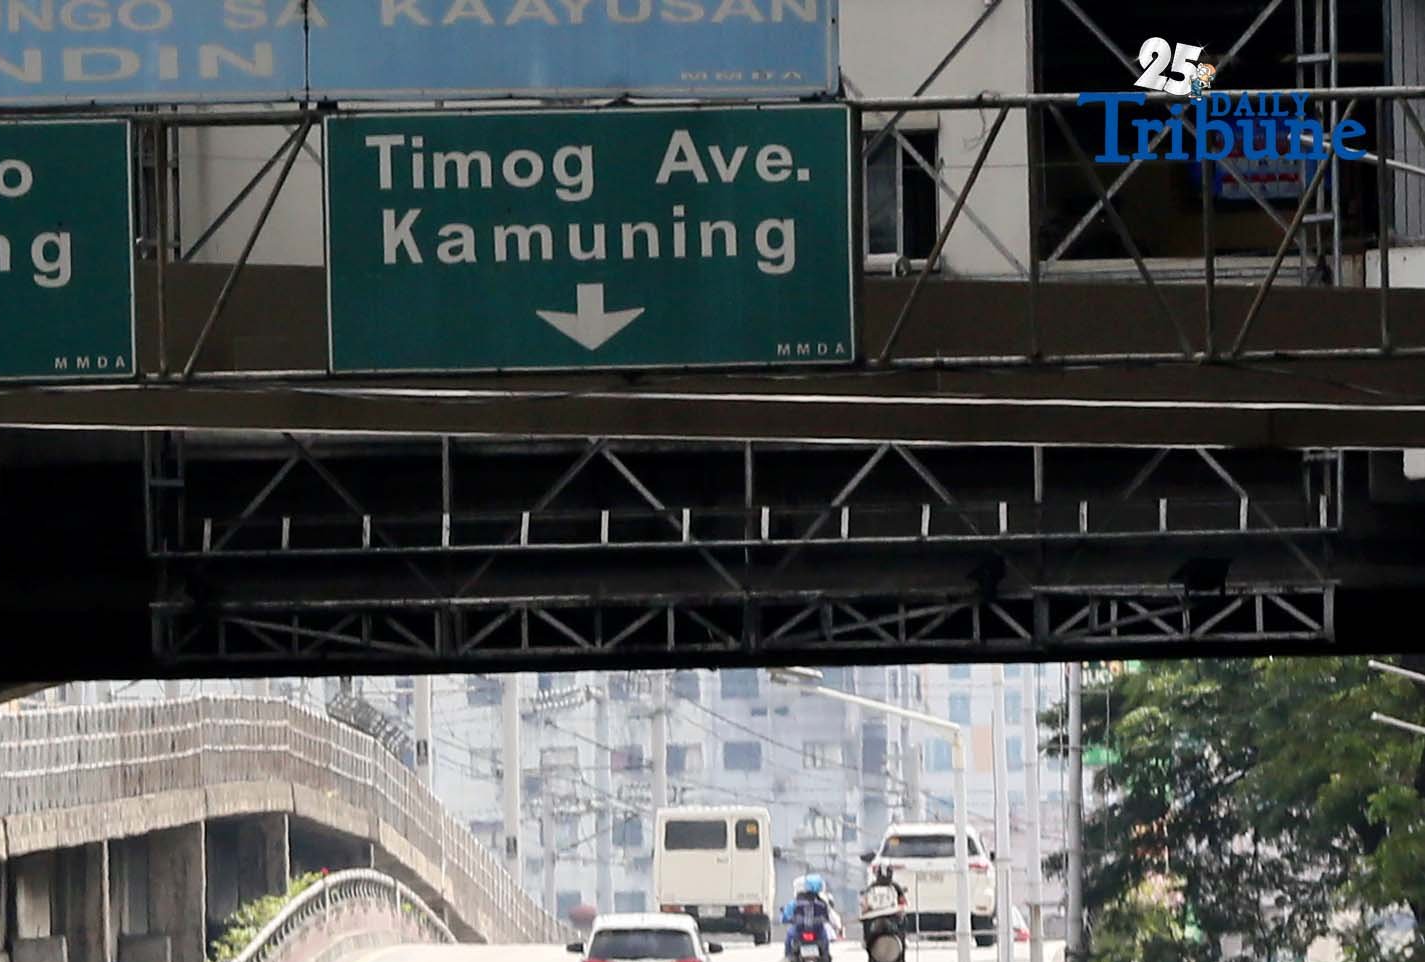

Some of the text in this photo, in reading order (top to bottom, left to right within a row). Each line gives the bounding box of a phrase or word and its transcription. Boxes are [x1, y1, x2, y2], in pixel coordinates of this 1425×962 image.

[223, 0, 328, 31] SA
[380, 0, 817, 27] KAAYUSAN
[366, 129, 812, 201] Timog Ave.
[382, 205, 797, 275] Kamuning
[54, 356, 127, 370] MMDA
[777, 342, 846, 356] MMDA
